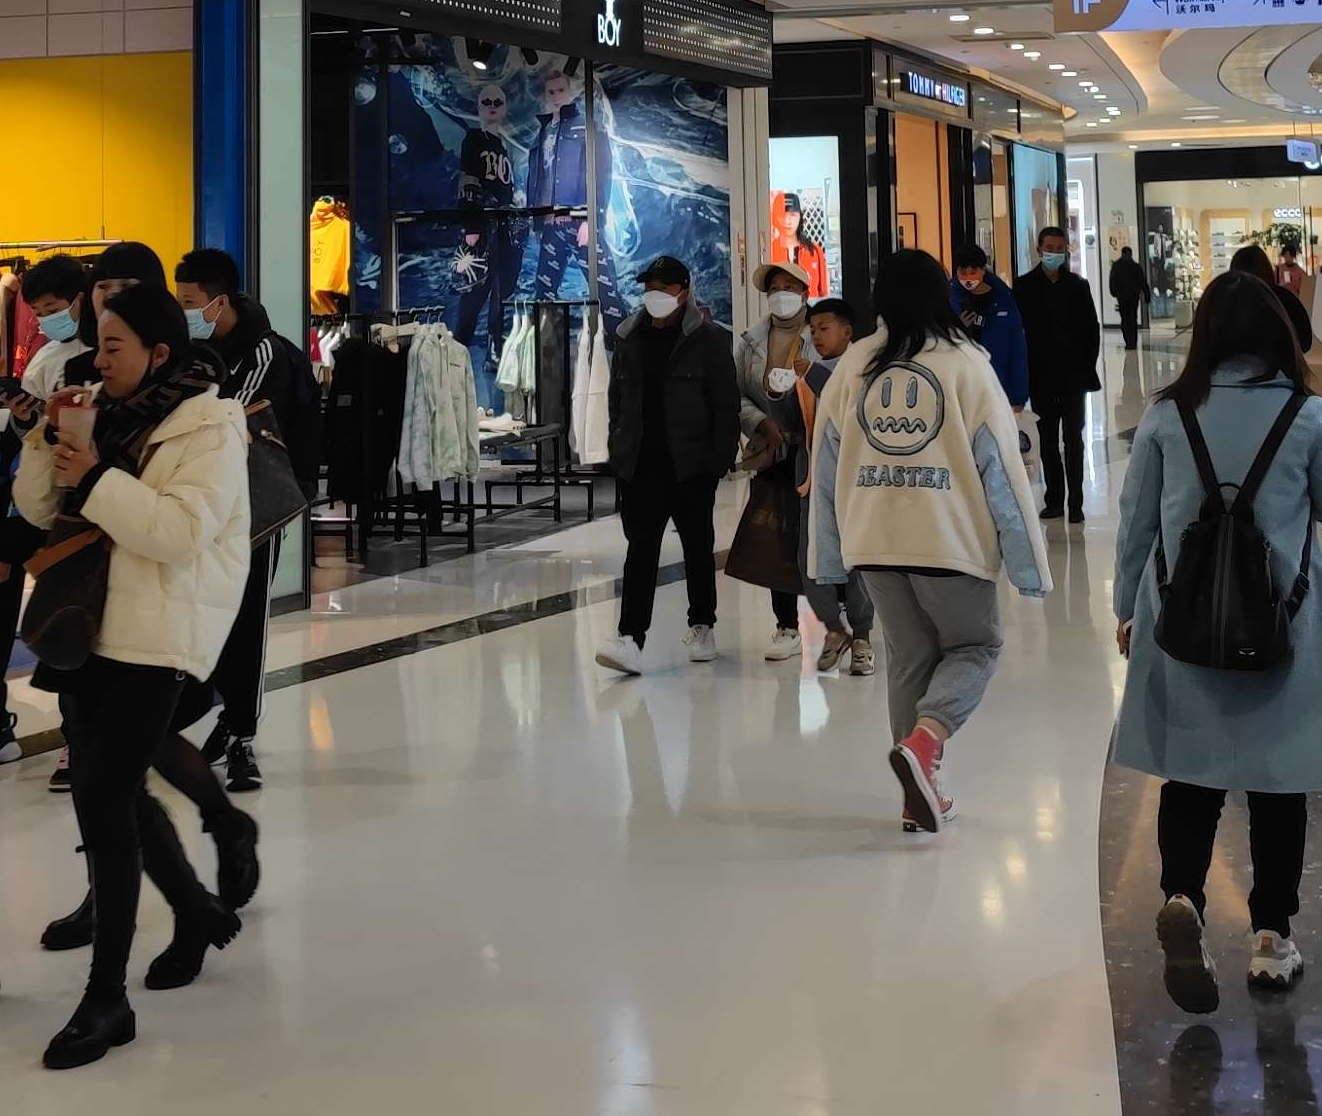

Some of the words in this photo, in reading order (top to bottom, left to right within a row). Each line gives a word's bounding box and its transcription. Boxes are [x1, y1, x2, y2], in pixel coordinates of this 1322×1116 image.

[1175, 3, 1216, 14] 沃尔玛
[597, 13, 622, 47] BOY
